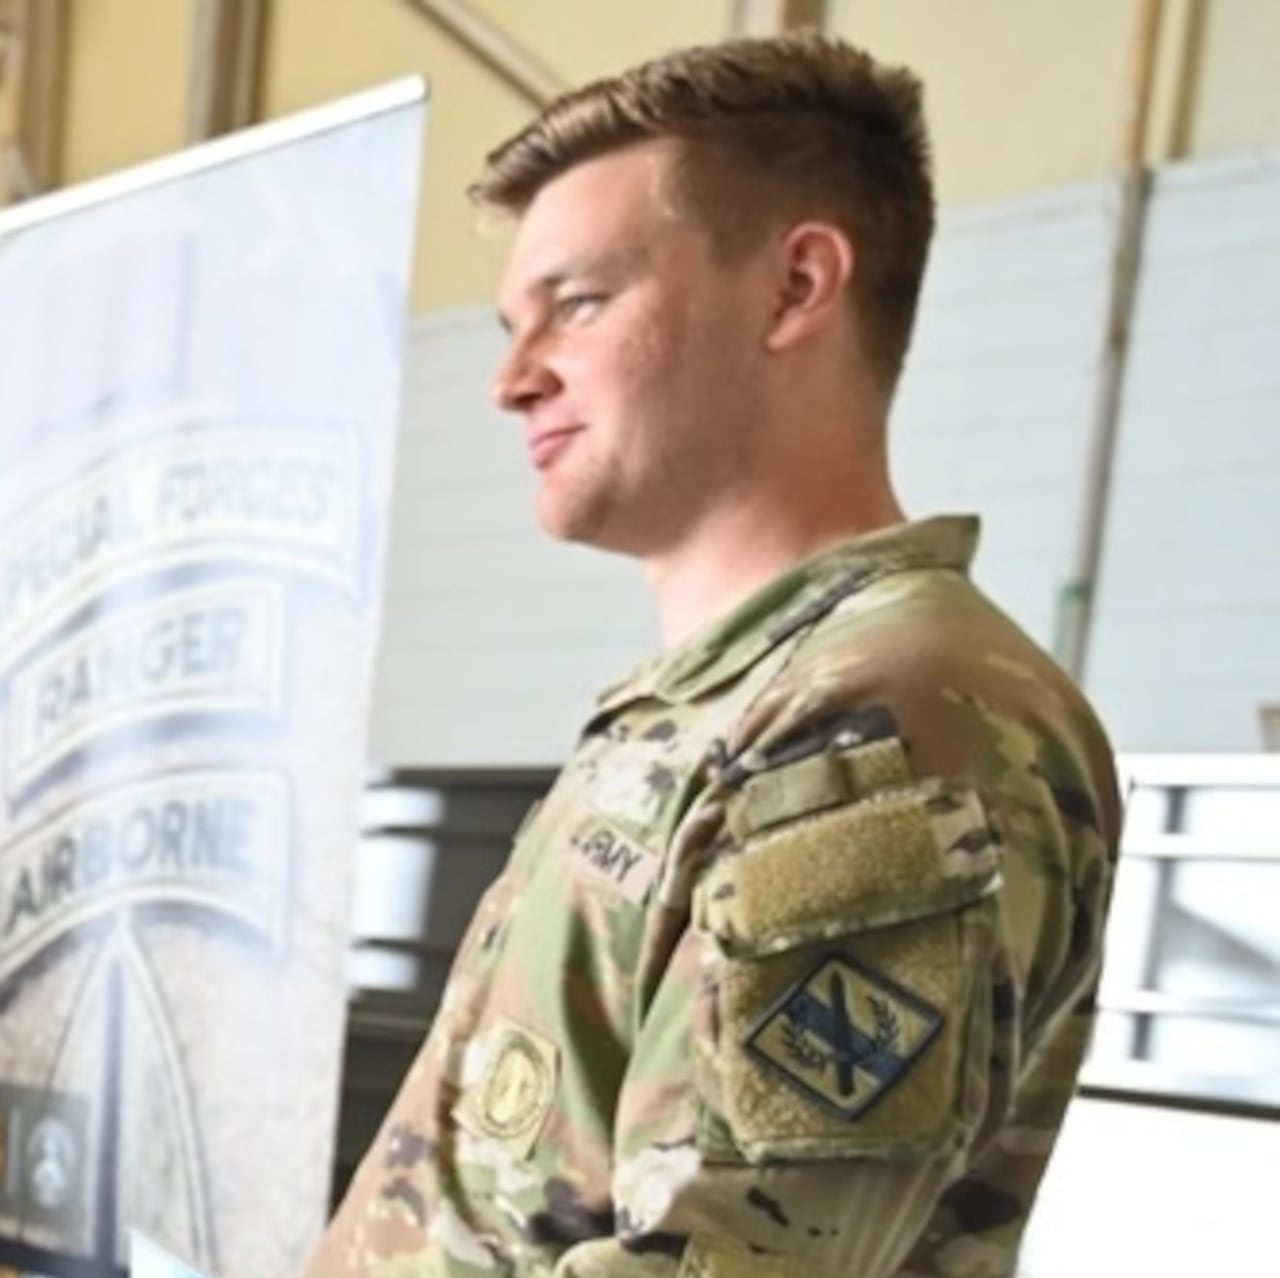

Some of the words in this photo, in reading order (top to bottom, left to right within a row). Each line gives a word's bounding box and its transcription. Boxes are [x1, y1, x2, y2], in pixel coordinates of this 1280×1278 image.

[155, 454, 335, 525] FORCES
[35, 605, 246, 738] RANGER
[2, 796, 255, 938] AIRBORNE
